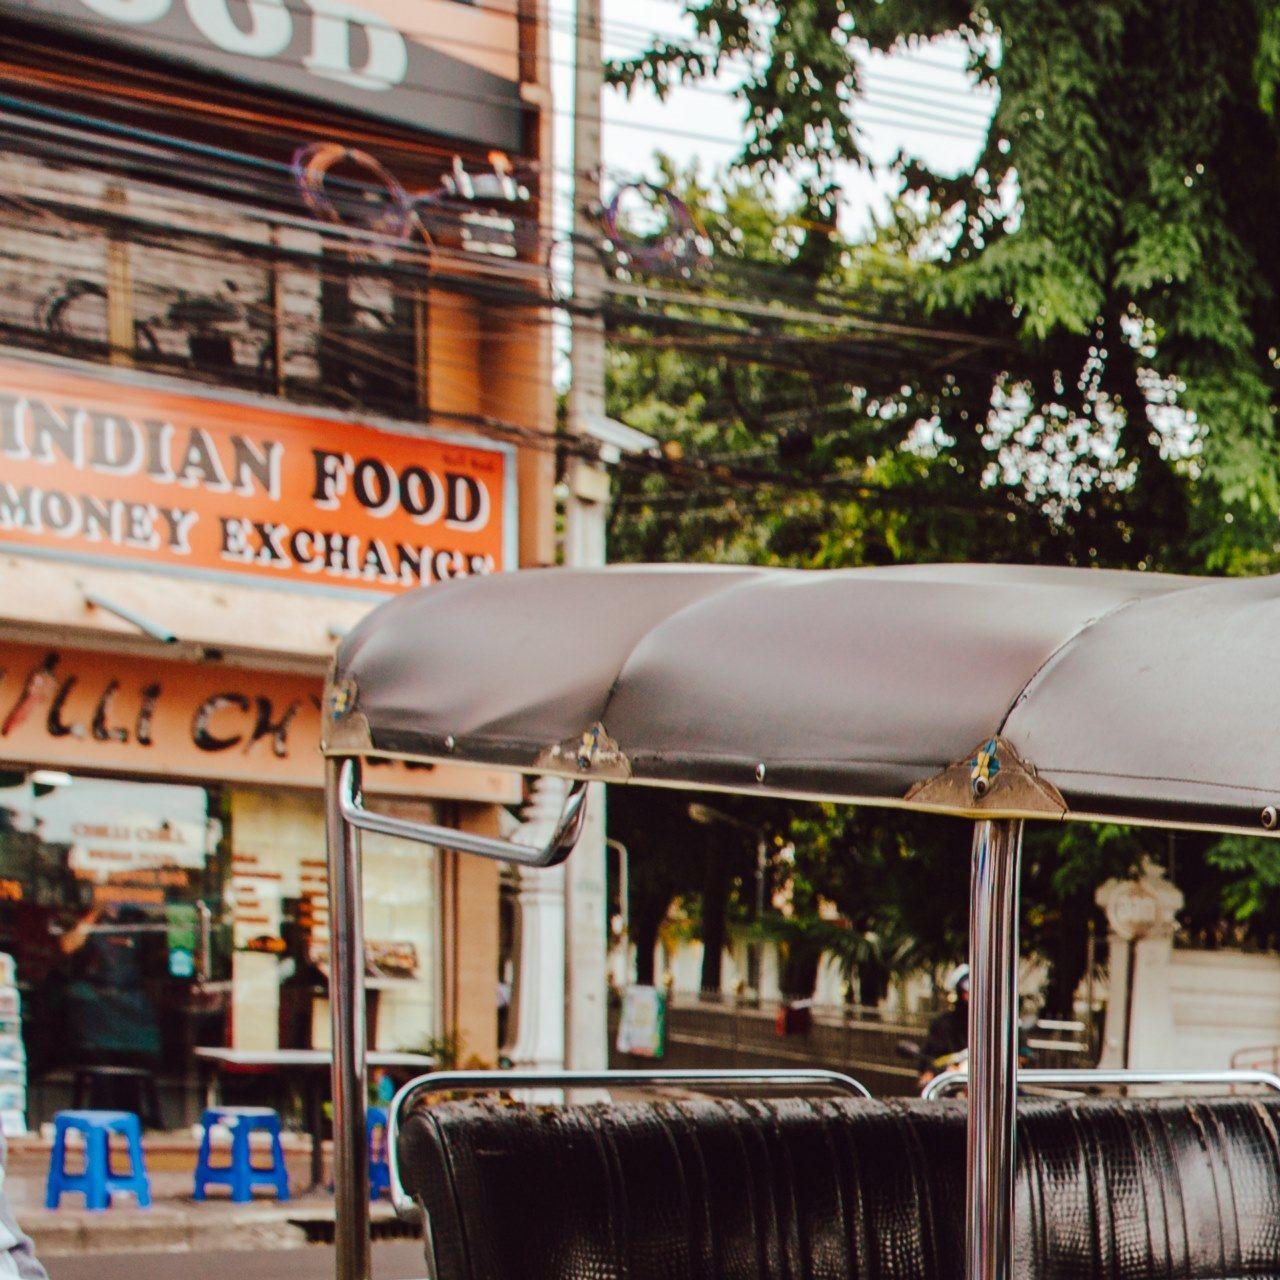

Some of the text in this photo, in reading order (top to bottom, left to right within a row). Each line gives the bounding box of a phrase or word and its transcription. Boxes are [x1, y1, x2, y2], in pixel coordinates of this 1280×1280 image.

[0, 394, 490, 532] INDIAN FOOD
[0, 483, 199, 555] MONEY
